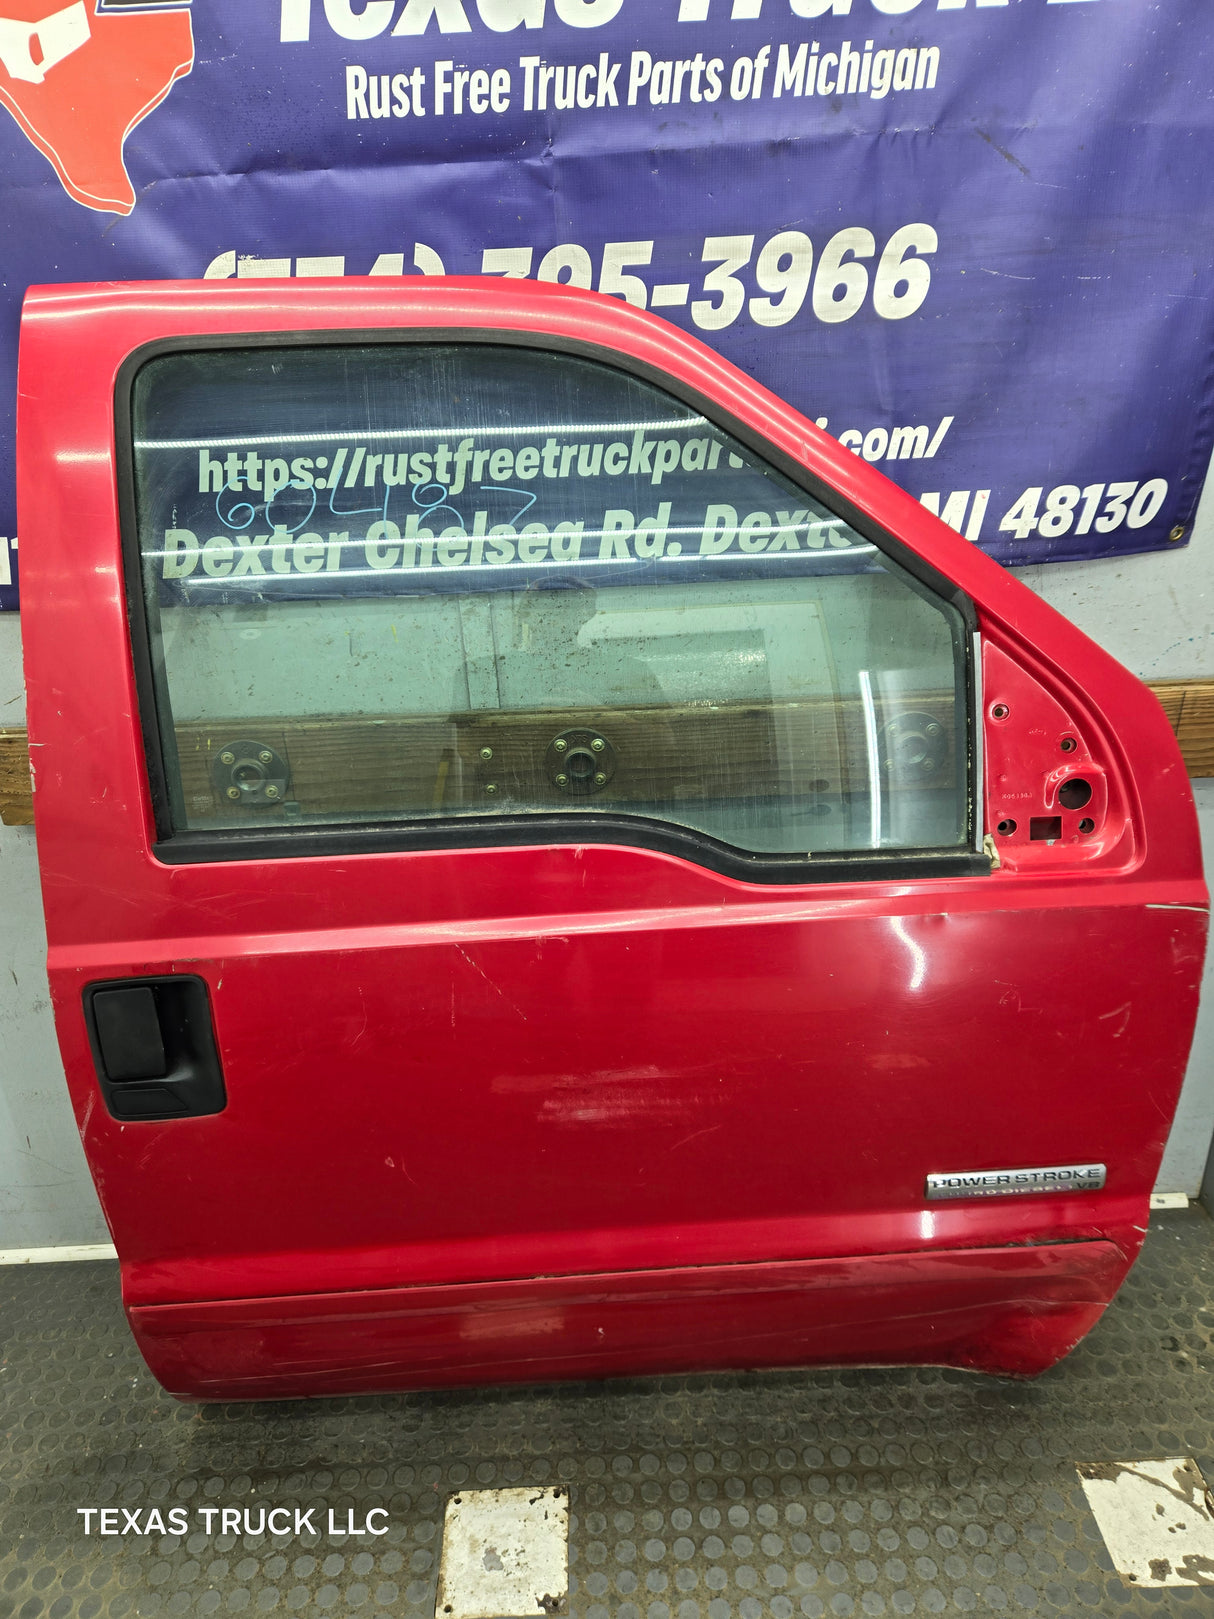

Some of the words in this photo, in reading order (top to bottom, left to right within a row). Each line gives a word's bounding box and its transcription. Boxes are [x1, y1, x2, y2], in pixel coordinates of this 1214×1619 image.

[345, 65, 426, 120] Rust
[434, 60, 511, 116] Free
[519, 53, 622, 112] Truck
[627, 50, 722, 106] Parts
[730, 44, 770, 100] of
[775, 38, 940, 100] Michigan
[162, 524, 348, 579] Dexter
[364, 511, 584, 570] Chelsea
[598, 501, 682, 559] Rd.
[998, 478, 1169, 539] 48130
[933, 1175, 1011, 1189] POWER
[1015, 1168, 1101, 1183] STROKE
